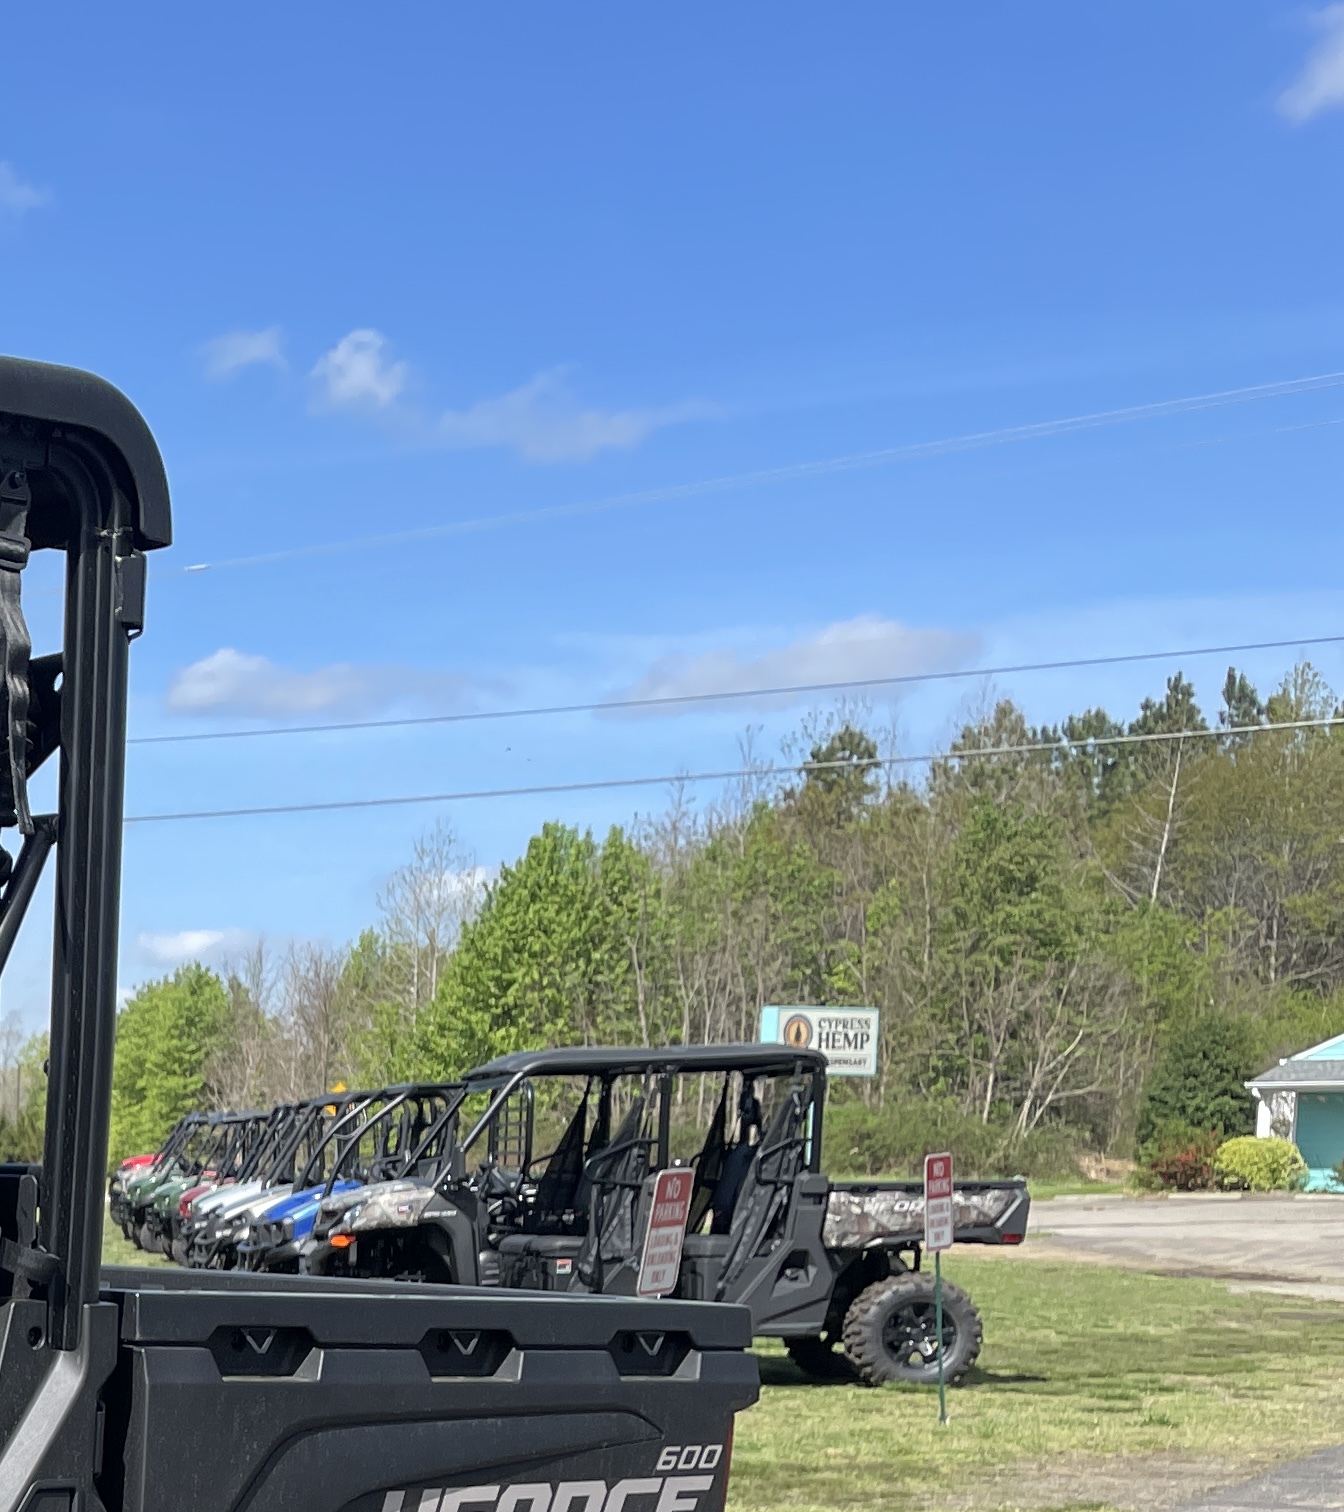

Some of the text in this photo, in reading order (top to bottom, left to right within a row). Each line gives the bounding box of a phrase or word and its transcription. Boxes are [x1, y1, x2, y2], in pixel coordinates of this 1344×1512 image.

[818, 1017, 872, 1030] CYPRESS
[818, 1031, 871, 1050] HEMP
[664, 1176, 682, 1200] NO
[655, 1444, 724, 1471] 600
